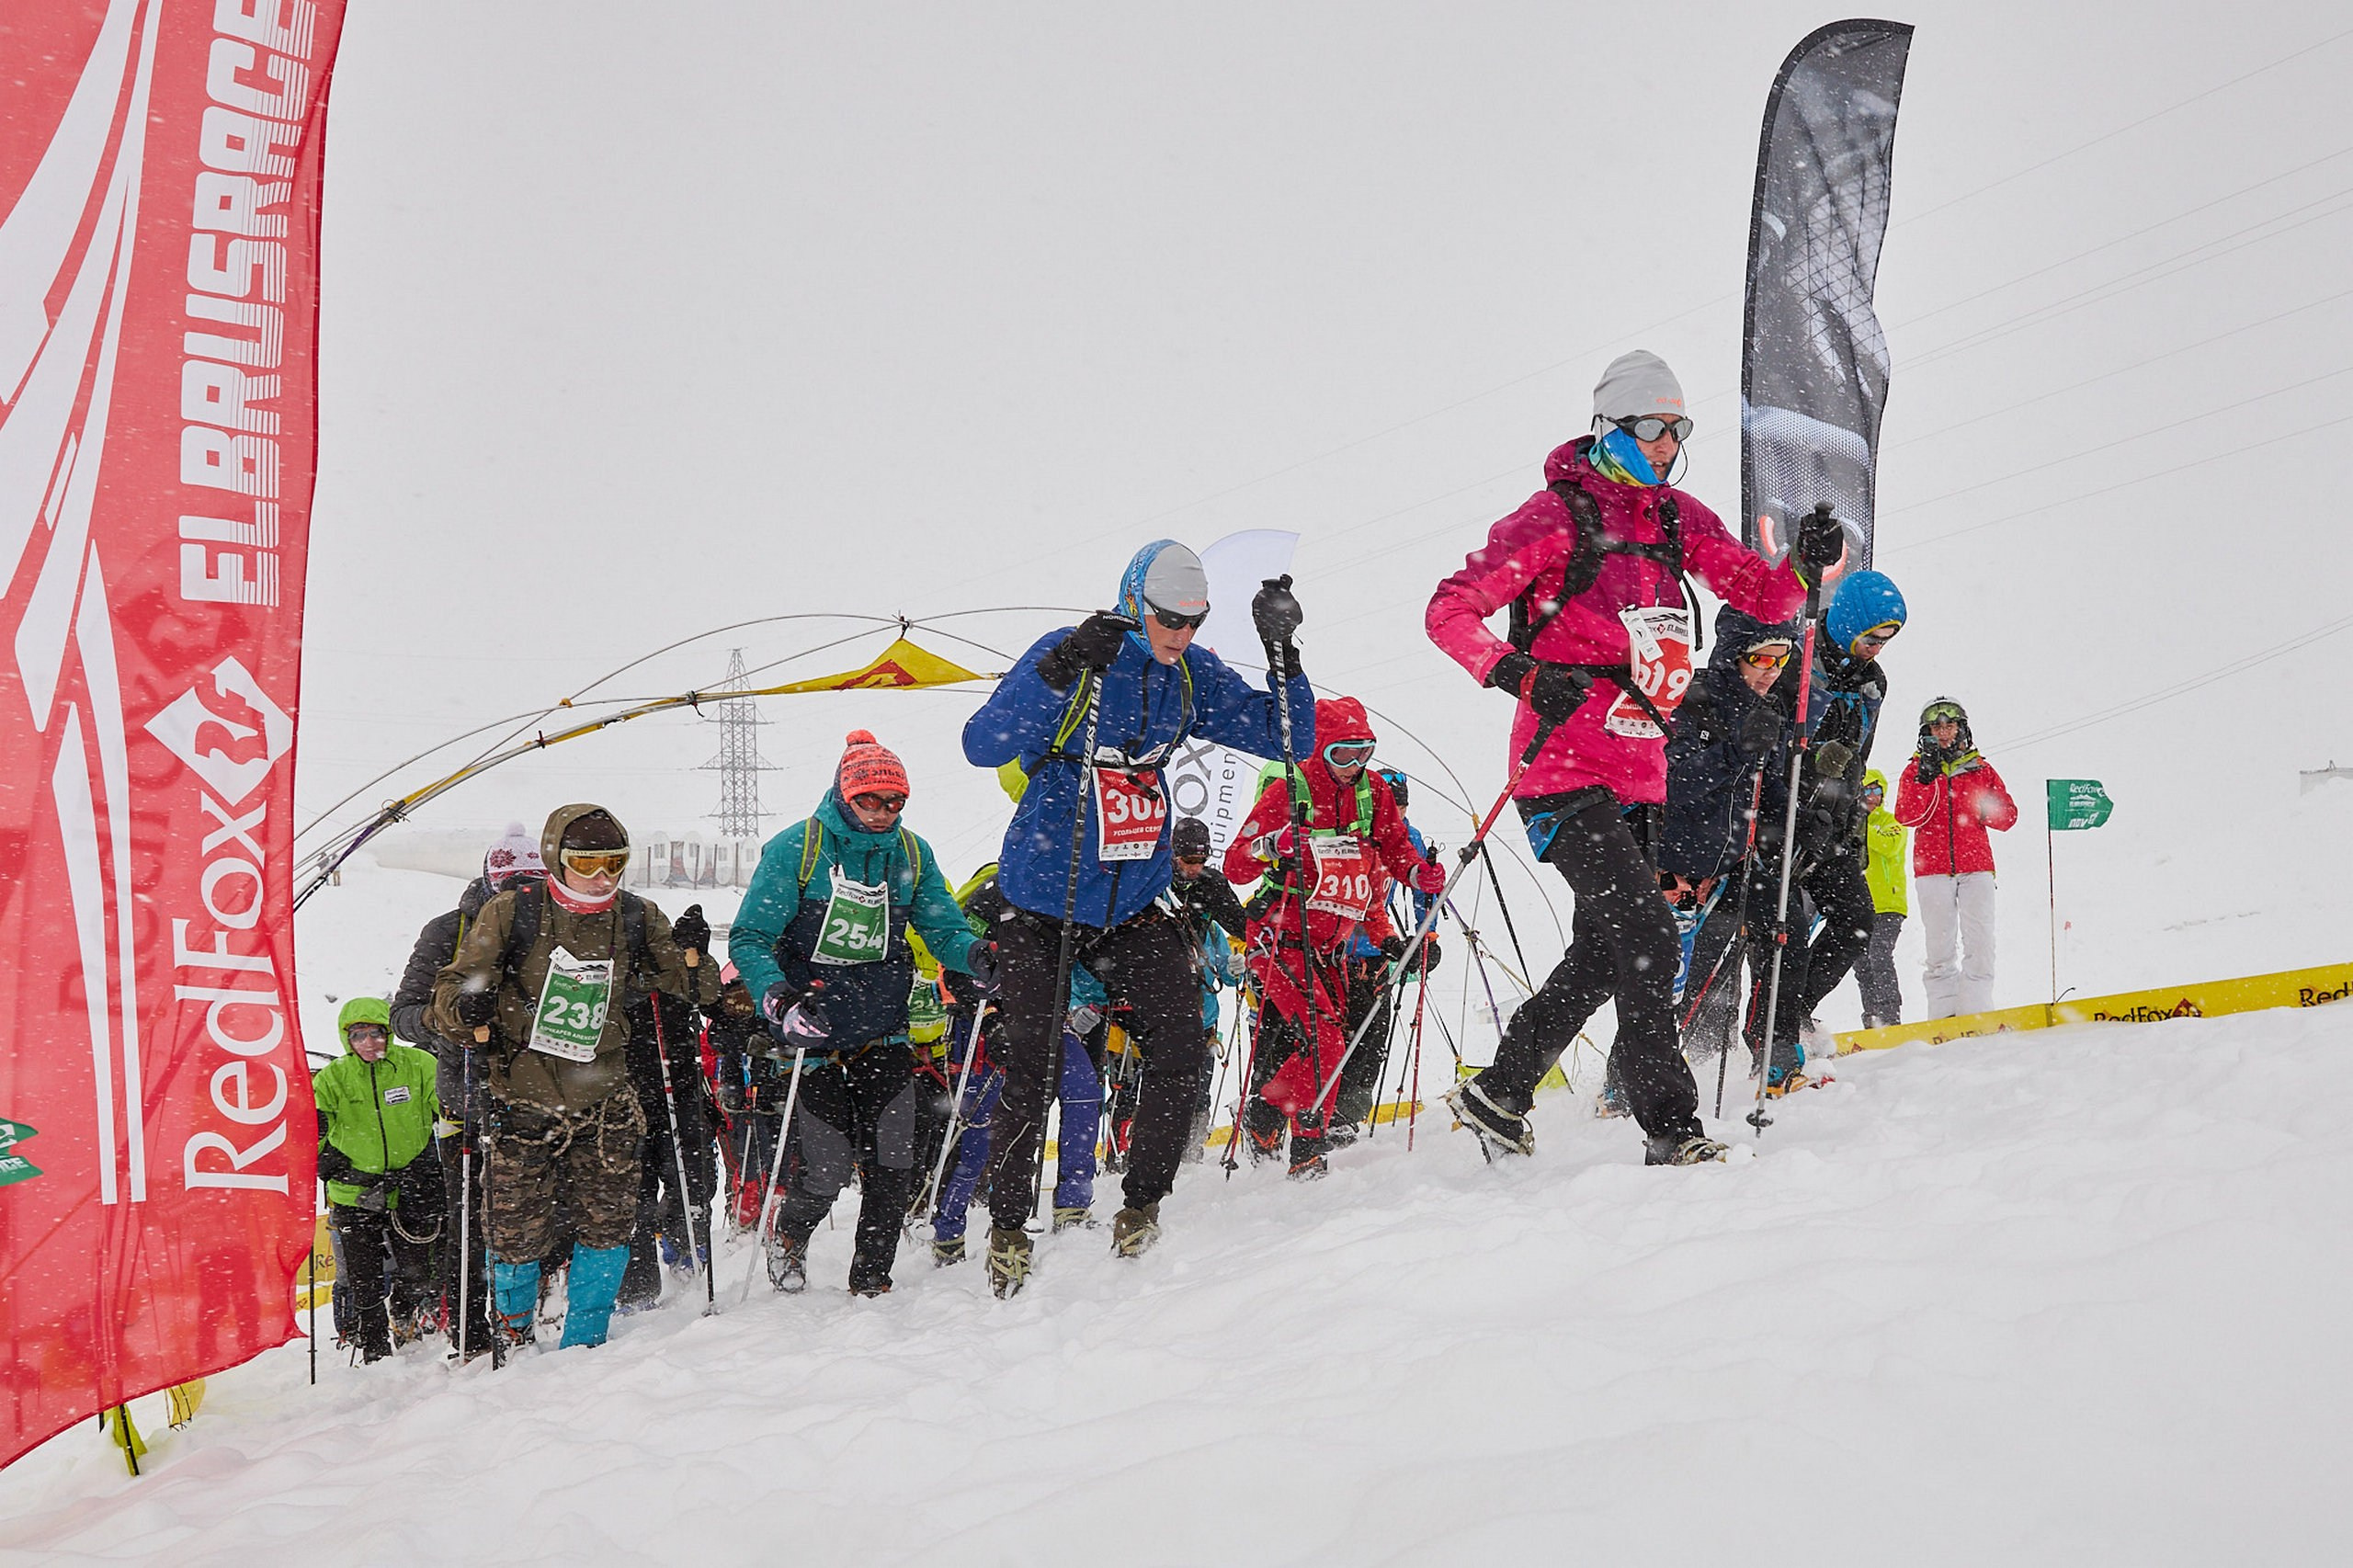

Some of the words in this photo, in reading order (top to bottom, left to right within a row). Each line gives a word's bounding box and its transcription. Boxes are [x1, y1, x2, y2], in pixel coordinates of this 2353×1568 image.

[179, 0, 316, 607] ELBRUSRACE
[1320, 874, 1370, 900] 310
[826, 917, 883, 950] 254
[172, 790, 290, 1196] RedFox
[543, 995, 606, 1030] 238
